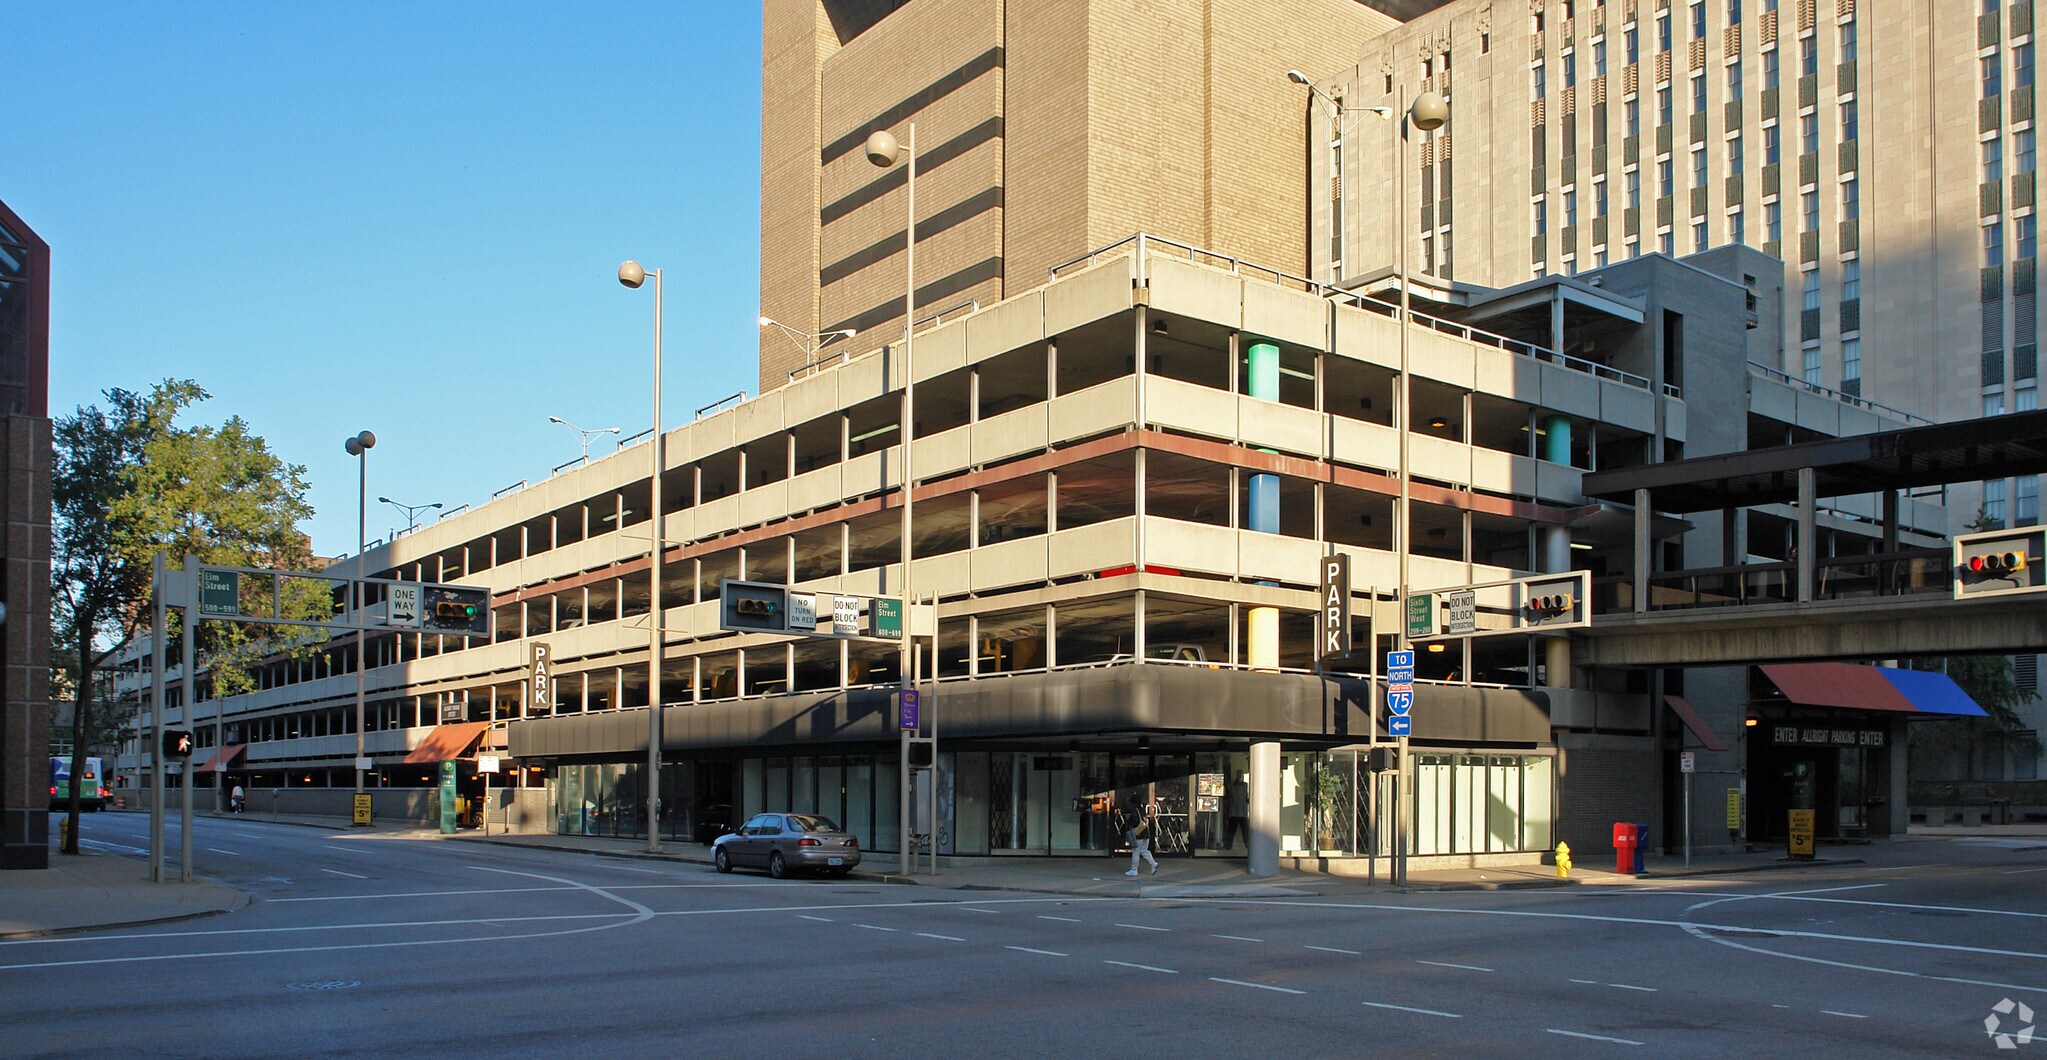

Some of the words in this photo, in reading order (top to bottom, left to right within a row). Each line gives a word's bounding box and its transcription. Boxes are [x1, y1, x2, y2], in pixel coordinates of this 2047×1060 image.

[205, 572, 220, 581] Elm
[205, 581, 230, 591] Street
[395, 589, 415, 600] ONE
[395, 601, 415, 610] WAY
[834, 601, 844, 610] DO
[845, 602, 858, 611] NOT
[878, 600, 889, 609] Elm
[1327, 562, 1341, 652] PARK
[1410, 597, 1425, 607] Sixth
[1451, 598, 1460, 608] DO
[1461, 596, 1474, 607] NOT
[205, 604, 236, 612] 500-599
[795, 607, 811, 615] TURN
[878, 609, 896, 617] Street
[1410, 606, 1428, 615] Street
[791, 615, 801, 623] ON
[802, 616, 814, 624] RED
[834, 612, 858, 622] BLOCK
[1410, 614, 1425, 623] West
[1451, 610, 1474, 621] BLOCK
[878, 628, 902, 637] 600-699
[1395, 655, 1407, 665] TO
[535, 647, 546, 704] PARK
[1389, 671, 1412, 681] NORTH
[1392, 693, 1410, 709] 75
[1775, 727, 1798, 743] ENTER
[1831, 730, 1855, 744] PARKING
[1859, 731, 1884, 745] ENTER
[446, 762, 451, 770] P
[1799, 765, 1805, 777] P
